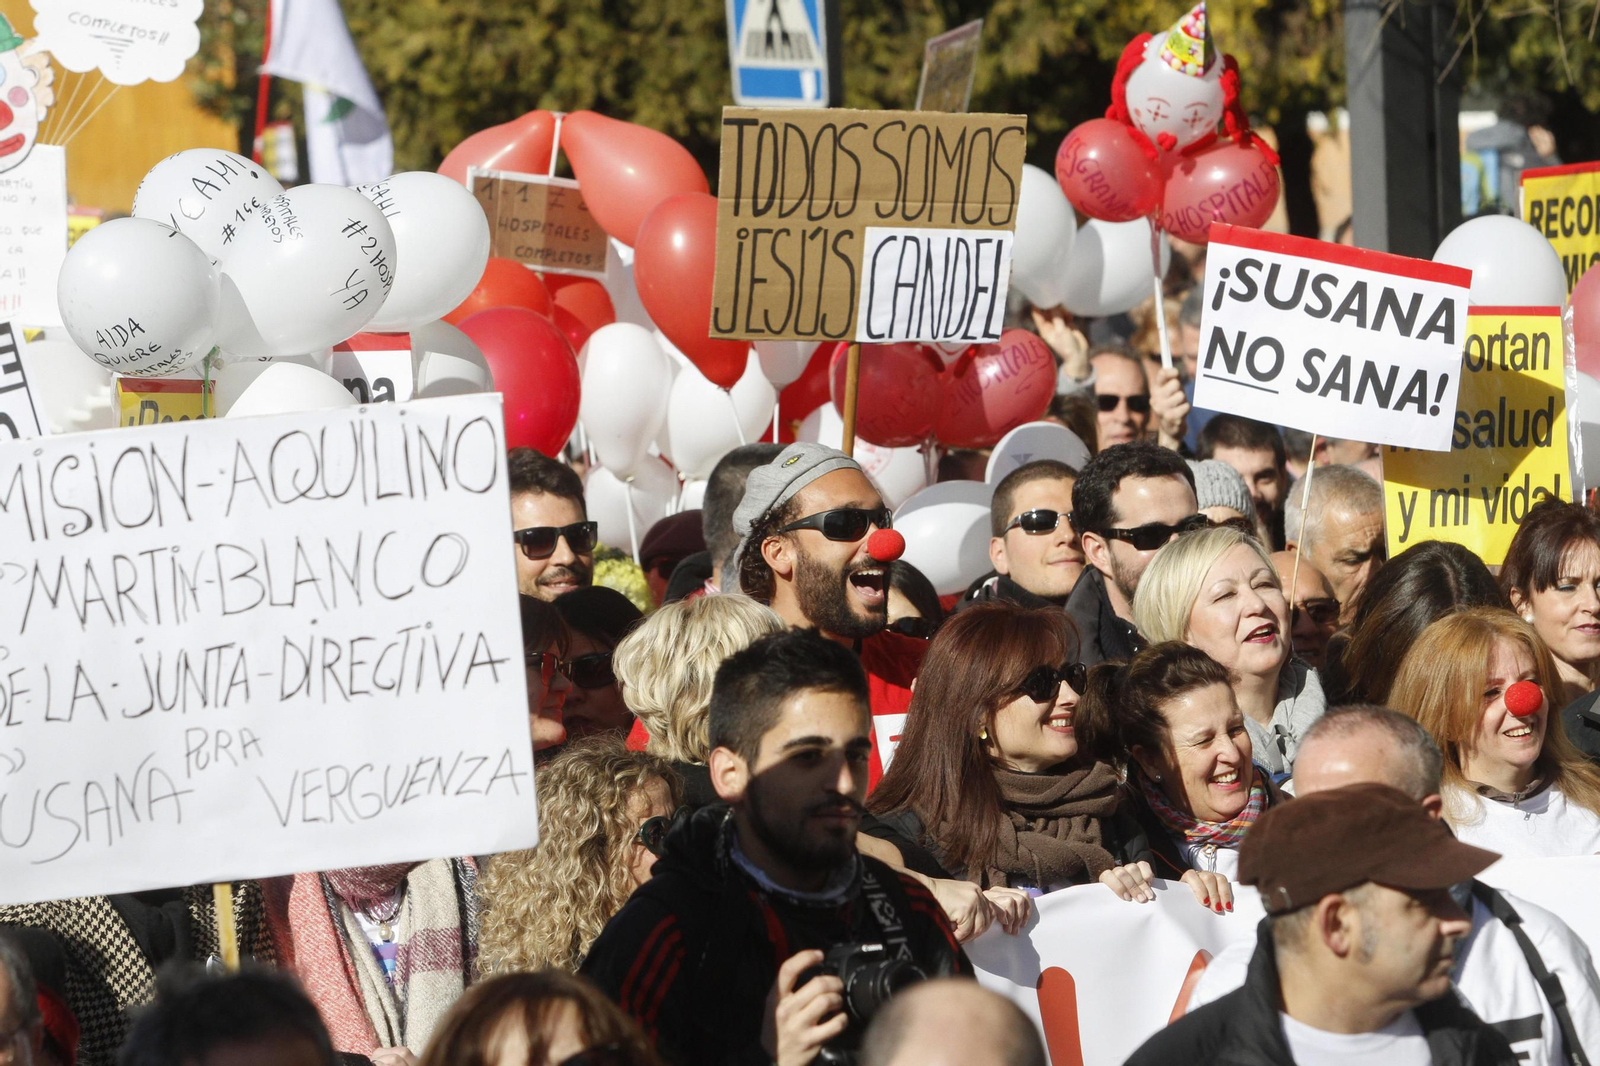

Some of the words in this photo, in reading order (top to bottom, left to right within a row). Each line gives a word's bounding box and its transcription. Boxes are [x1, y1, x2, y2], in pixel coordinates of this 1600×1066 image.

[723, 117, 869, 222] TODOS
[873, 119, 1025, 227] SOMOS
[498, 216, 591, 242] HOSPITALES
[515, 245, 592, 266] COMPLETOS
[865, 235, 1004, 341] CANDEL
[1211, 257, 1456, 346] ¡SUSANA
[94, 341, 162, 367] QUIERE
[96, 317, 146, 349] AIDA
[1461, 321, 1551, 373] ortan
[1203, 325, 1286, 383] NO
[1295, 347, 1450, 417] SANA!
[1451, 396, 1555, 450] salud
[1397, 491, 1419, 544] y
[1428, 473, 1471, 528] mi
[257, 747, 528, 827] VERGUENZA
